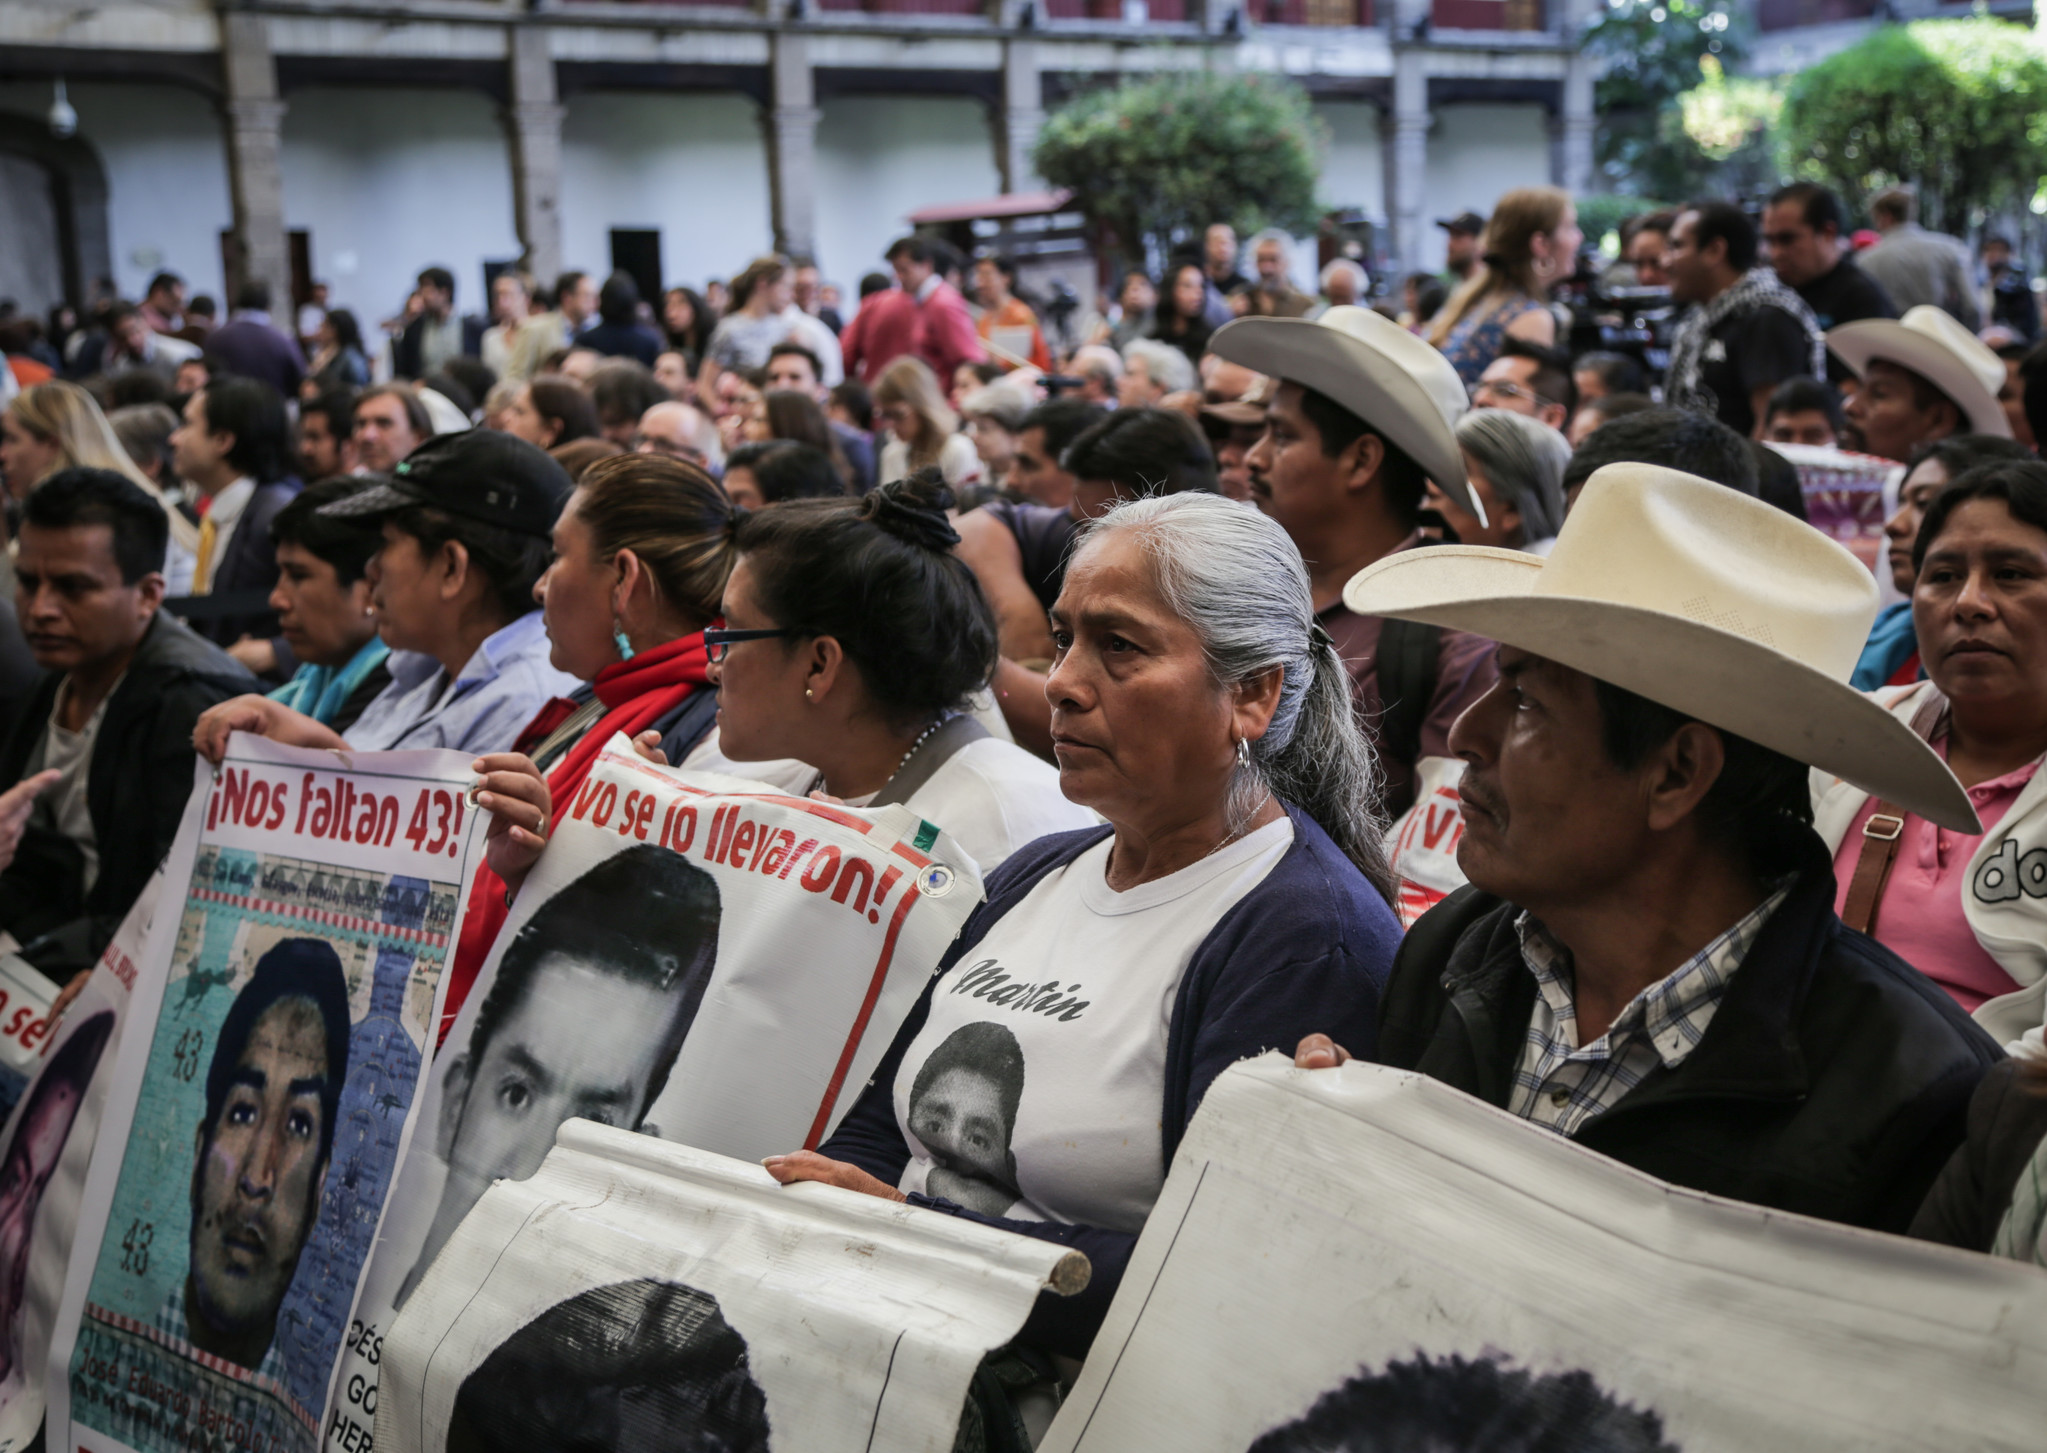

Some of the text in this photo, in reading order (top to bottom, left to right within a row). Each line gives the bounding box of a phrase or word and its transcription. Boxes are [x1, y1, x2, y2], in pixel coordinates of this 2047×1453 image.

[206, 767, 465, 858] ¡Nos faltan 43!
[619, 788, 656, 841] se
[659, 793, 697, 854] lo
[704, 800, 904, 925] llevaron!
[2, 1006, 47, 1051] se
[79, 1347, 119, 1385] José
[127, 1365, 191, 1418] Eduardo
